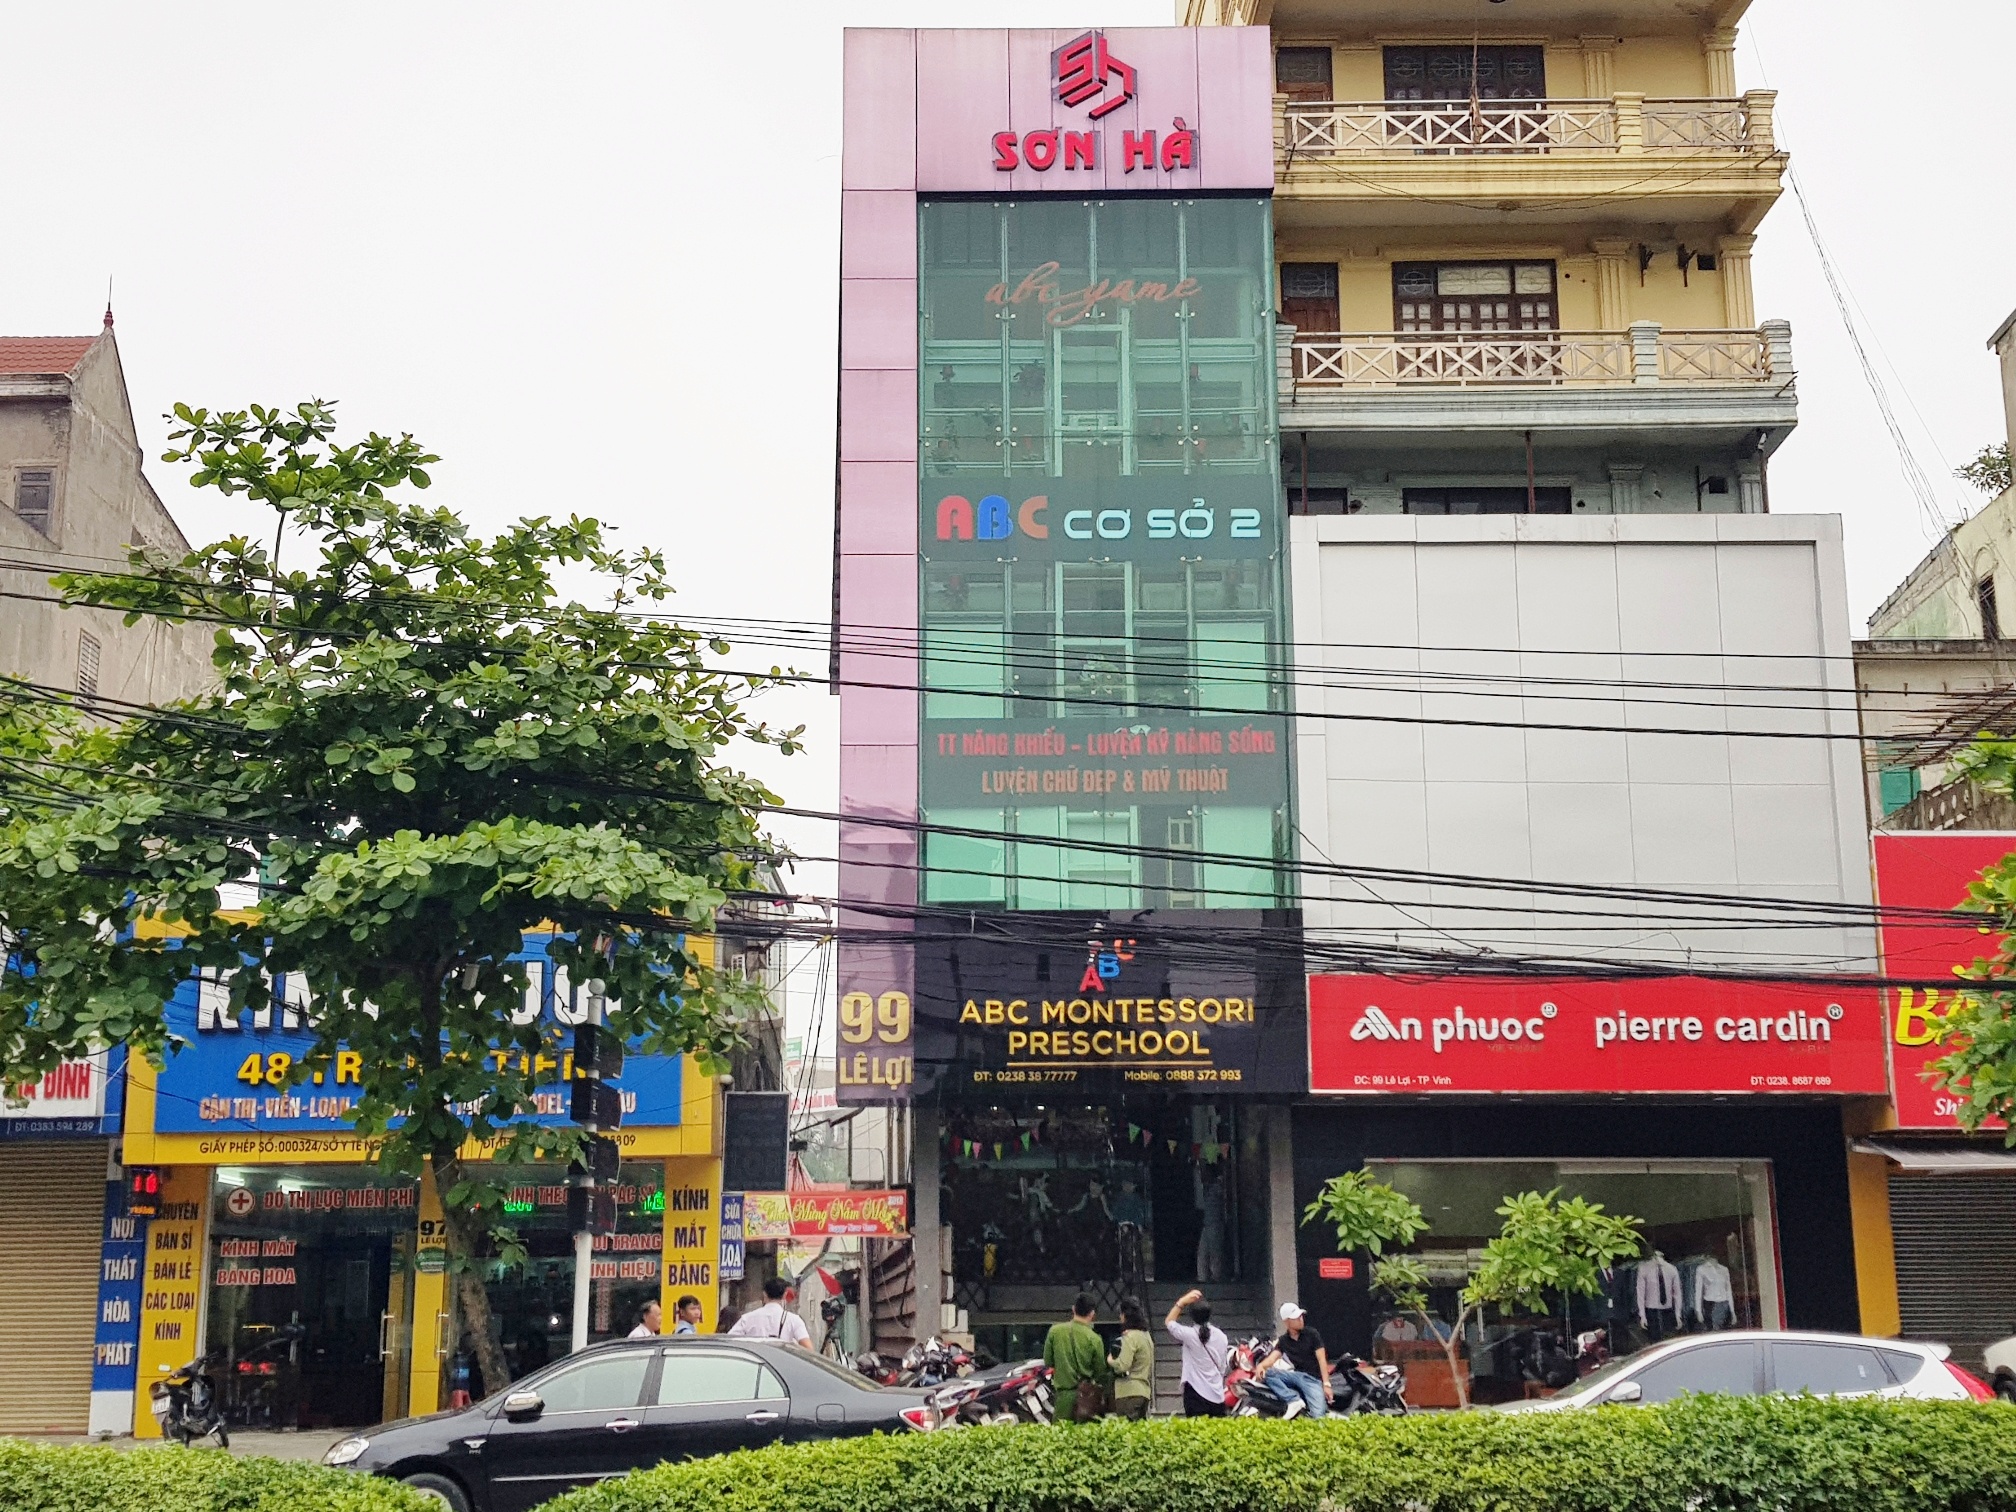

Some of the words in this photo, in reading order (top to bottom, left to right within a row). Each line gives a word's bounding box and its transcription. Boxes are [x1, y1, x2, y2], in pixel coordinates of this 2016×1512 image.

[992, 126, 1100, 172] SƠN
[1123, 117, 1199, 174] HÀ
[936, 495, 1049, 541] ABC
[1063, 508, 1132, 540] CƠ
[1146, 497, 1214, 539] SỞ
[1230, 508, 1262, 539] 2
[937, 733, 957, 757] TT
[962, 728, 1009, 757] NĂNG
[1014, 725, 1066, 756] KHIẾU
[1174, 727, 1222, 754] NĂNG
[1228, 723, 1276, 755] SỐNG
[981, 765, 1039, 797] LUYỆN
[1042, 764, 1080, 794] CHỮ
[1083, 768, 1118, 797] ĐẸP
[1123, 769, 1136, 793] &
[1141, 765, 1171, 793] MỸ
[1177, 763, 1229, 796] THUẬT
[840, 990, 911, 1044] 99
[959, 999, 1029, 1025] ABC
[1041, 997, 1256, 1025] MONTESSORI
[1432, 1005, 1545, 1053] phuoc
[1595, 1010, 1704, 1049] pierre
[1714, 1010, 1832, 1042] cardin
[1008, 1030, 1210, 1056] PRESCHOOL
[839, 1051, 869, 1085] LÊ
[872, 1055, 913, 1092] LỢI
[974, 1071, 993, 1082] ĐT:
[997, 1070, 1026, 1082] 0238
[1124, 1070, 1163, 1082] Mobile:
[1165, 1070, 1195, 1081] 0888
[1197, 1070, 1218, 1081] 372
[1220, 1069, 1242, 1081] 993
[1417, 1075, 1429, 1084] TP
[200, 1137, 226, 1154] GIẤY
[229, 1138, 256, 1152] PHÉP
[673, 1185, 709, 1211] KÍNH
[155, 1231, 178, 1250] BÁN
[674, 1219, 707, 1249] MẮT
[221, 1238, 260, 1257] KÍNH
[721, 1243, 741, 1267] LOA
[104, 1252, 138, 1281] THẤT
[153, 1260, 175, 1280] BÁN
[263, 1268, 296, 1284] HOA
[668, 1255, 711, 1286] BẰNG
[103, 1296, 130, 1323] HÒA
[145, 1289, 167, 1311] CÁC
[170, 1292, 195, 1314] LOẠI
[154, 1319, 181, 1341] KÍNH
